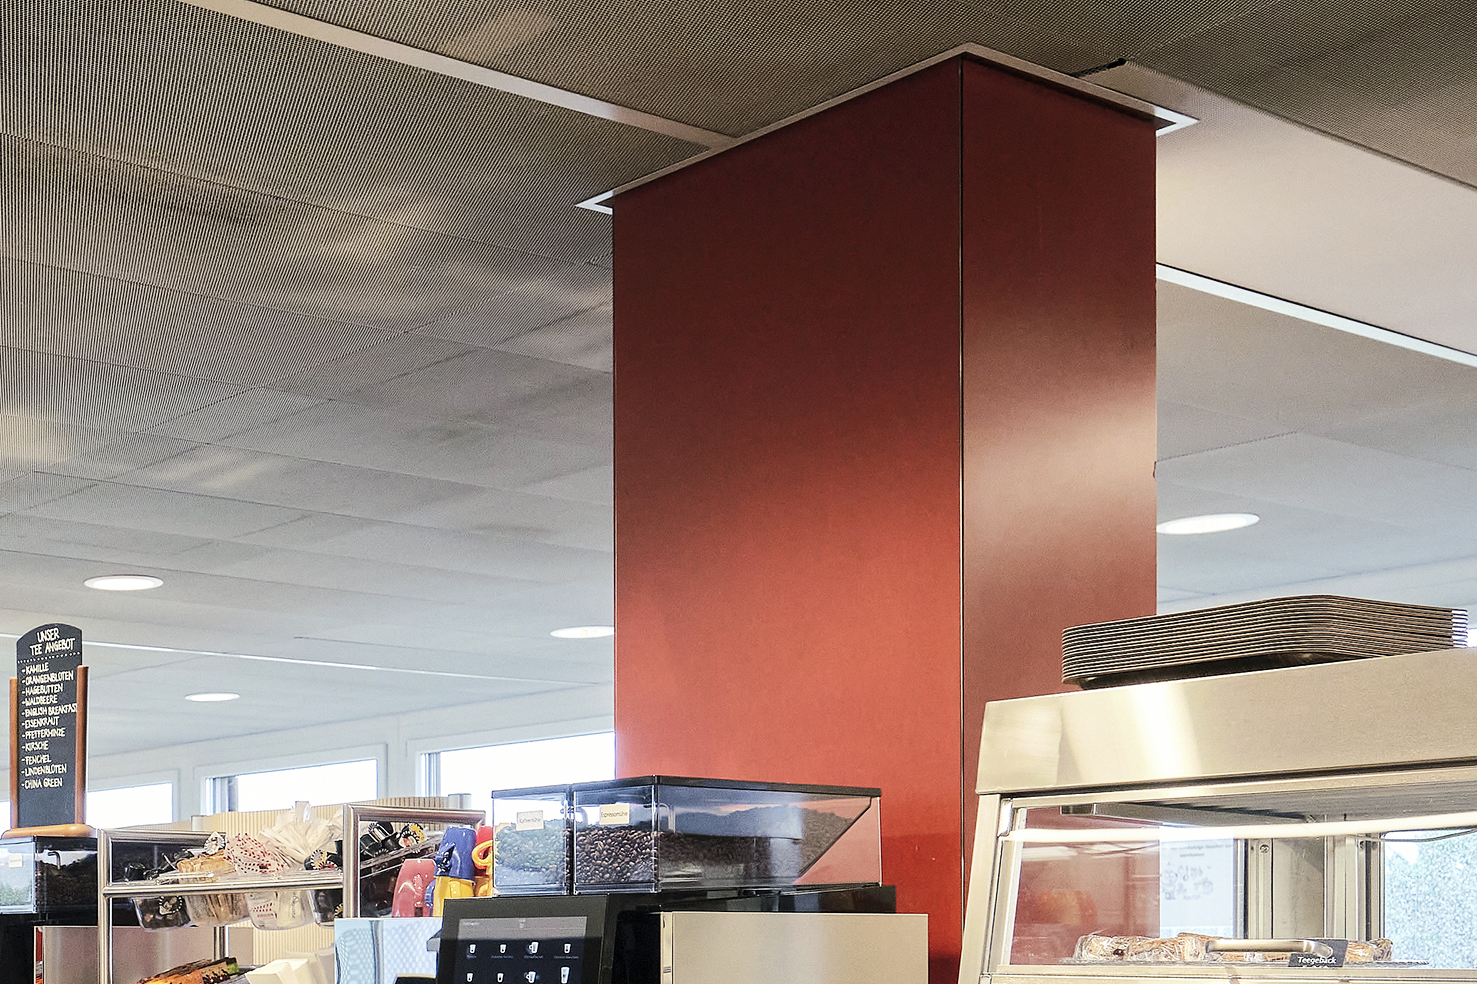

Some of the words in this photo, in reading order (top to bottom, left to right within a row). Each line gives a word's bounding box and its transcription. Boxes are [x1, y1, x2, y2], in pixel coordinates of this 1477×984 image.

[37, 627, 60, 643] UNSER
[29, 643, 43, 656] TEE
[44, 638, 75, 653] ANGEBOT
[43, 777, 63, 788] GREEN
